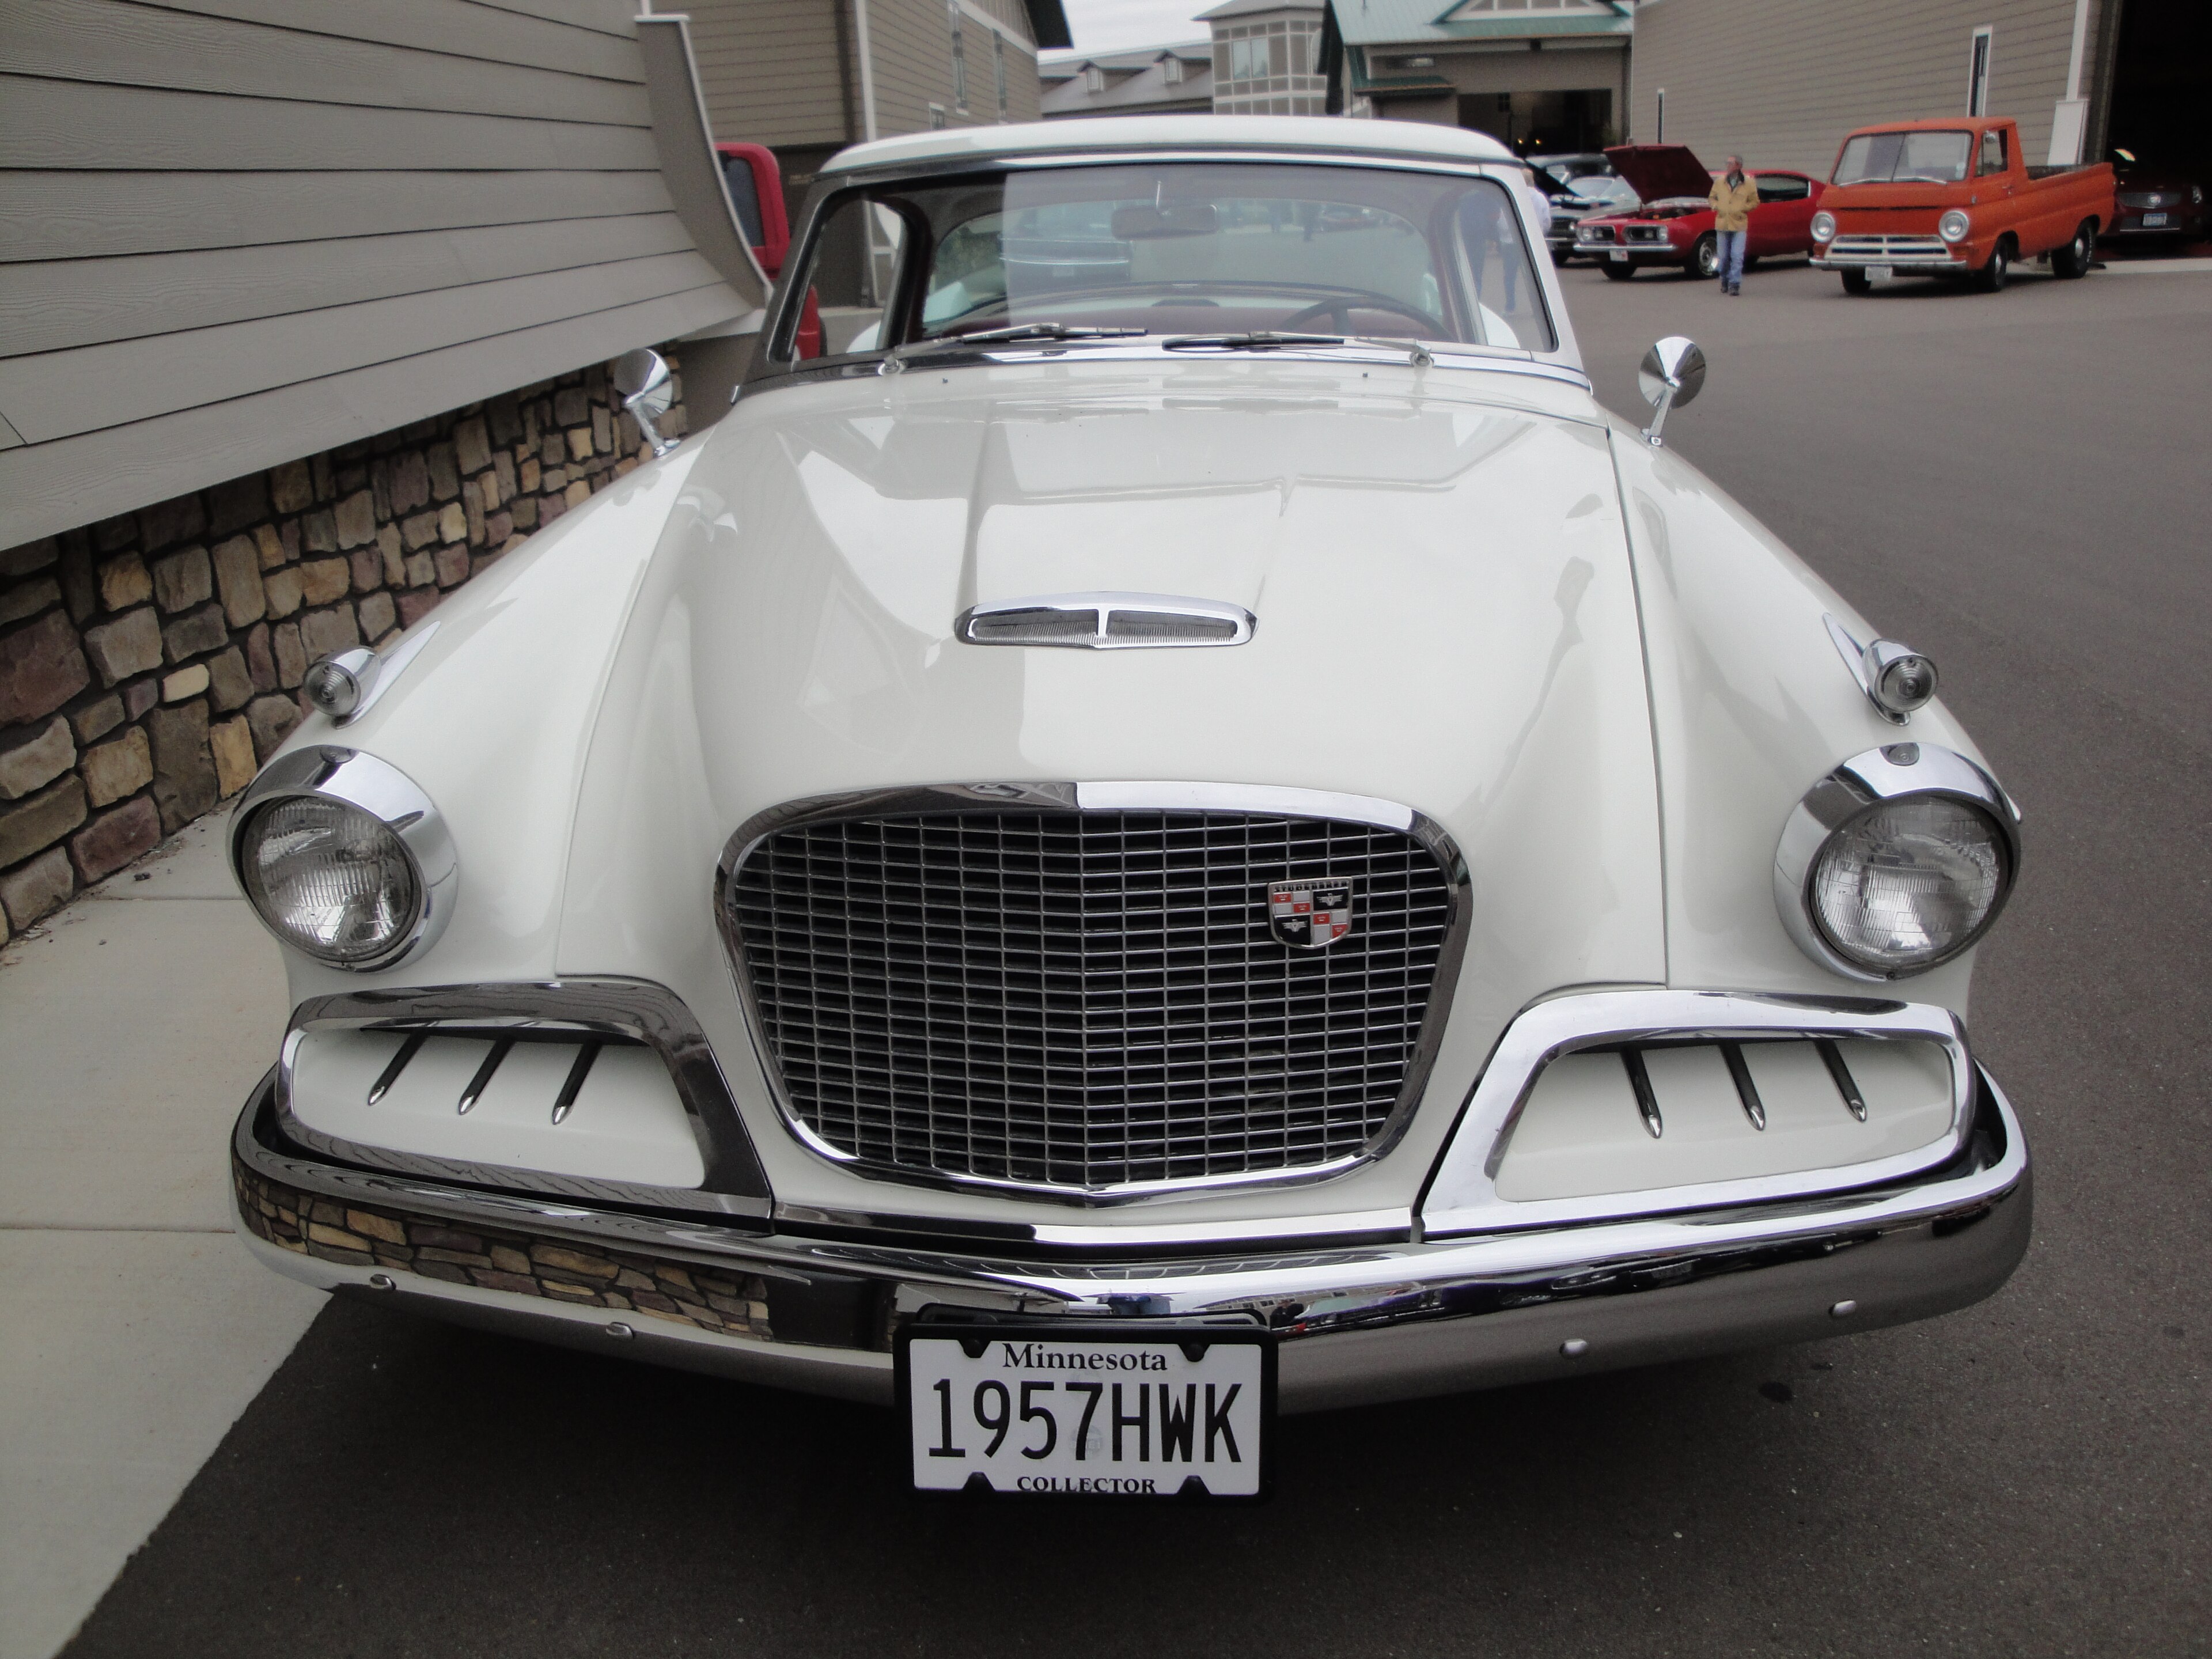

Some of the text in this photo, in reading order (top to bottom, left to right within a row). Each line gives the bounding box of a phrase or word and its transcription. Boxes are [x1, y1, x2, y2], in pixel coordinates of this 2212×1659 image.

[1002, 1343, 1168, 1371] Minnesota
[929, 1378, 1242, 1463] 1957HWK
[1017, 1476, 1156, 1493] COLLECTOR
